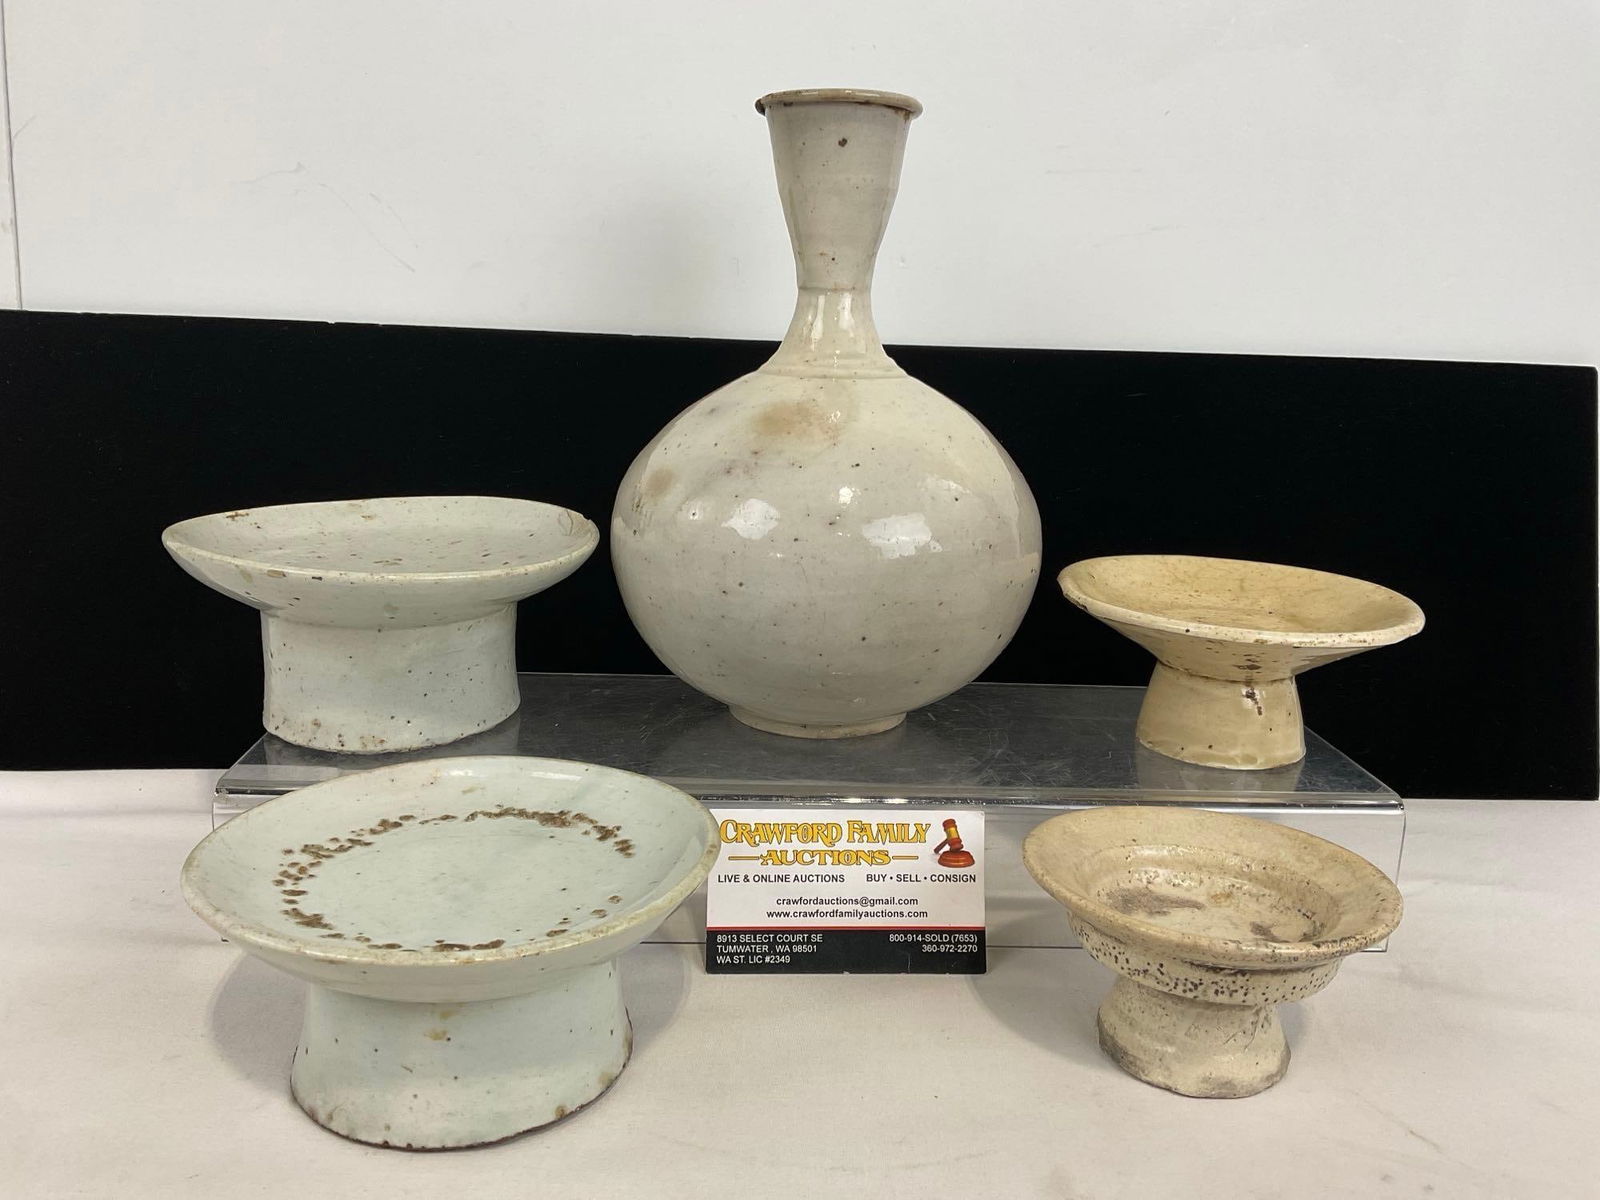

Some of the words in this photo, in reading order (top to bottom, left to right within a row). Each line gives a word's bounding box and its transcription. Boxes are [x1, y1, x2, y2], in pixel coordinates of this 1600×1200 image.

[719, 819, 843, 847] CRAWFORD
[847, 820, 932, 847] FAMILY
[760, 849, 891, 867] AUCTIONS
[717, 874, 742, 883] LIVE
[743, 874, 751, 883] &
[752, 874, 791, 883] ONLINE
[793, 874, 845, 883] AUCTIONS
[866, 873, 886, 883] BUY
[896, 873, 921, 883] SELL
[930, 873, 977, 883] CONSIGN
[776, 896, 919, 908] crawfordauctions@gmail.com
[766, 909, 928, 920] www.crawfordfamilyauctions.com
[716, 934, 738, 943] 8913
[739, 934, 775, 943] SELECT
[776, 934, 809, 943] COURT
[810, 934, 823, 943] SE
[889, 934, 950, 943] 800-914-SOLD
[951, 934, 978, 944] (7653)
[775, 944, 791, 953] WA
[792, 944, 817, 953] 98501
[921, 944, 978, 953] 360-972-2270
[716, 955, 732, 964] WA
[733, 955, 747, 964] ST.
[748, 955, 763, 964] LIC
[764, 955, 791, 964] #2349
